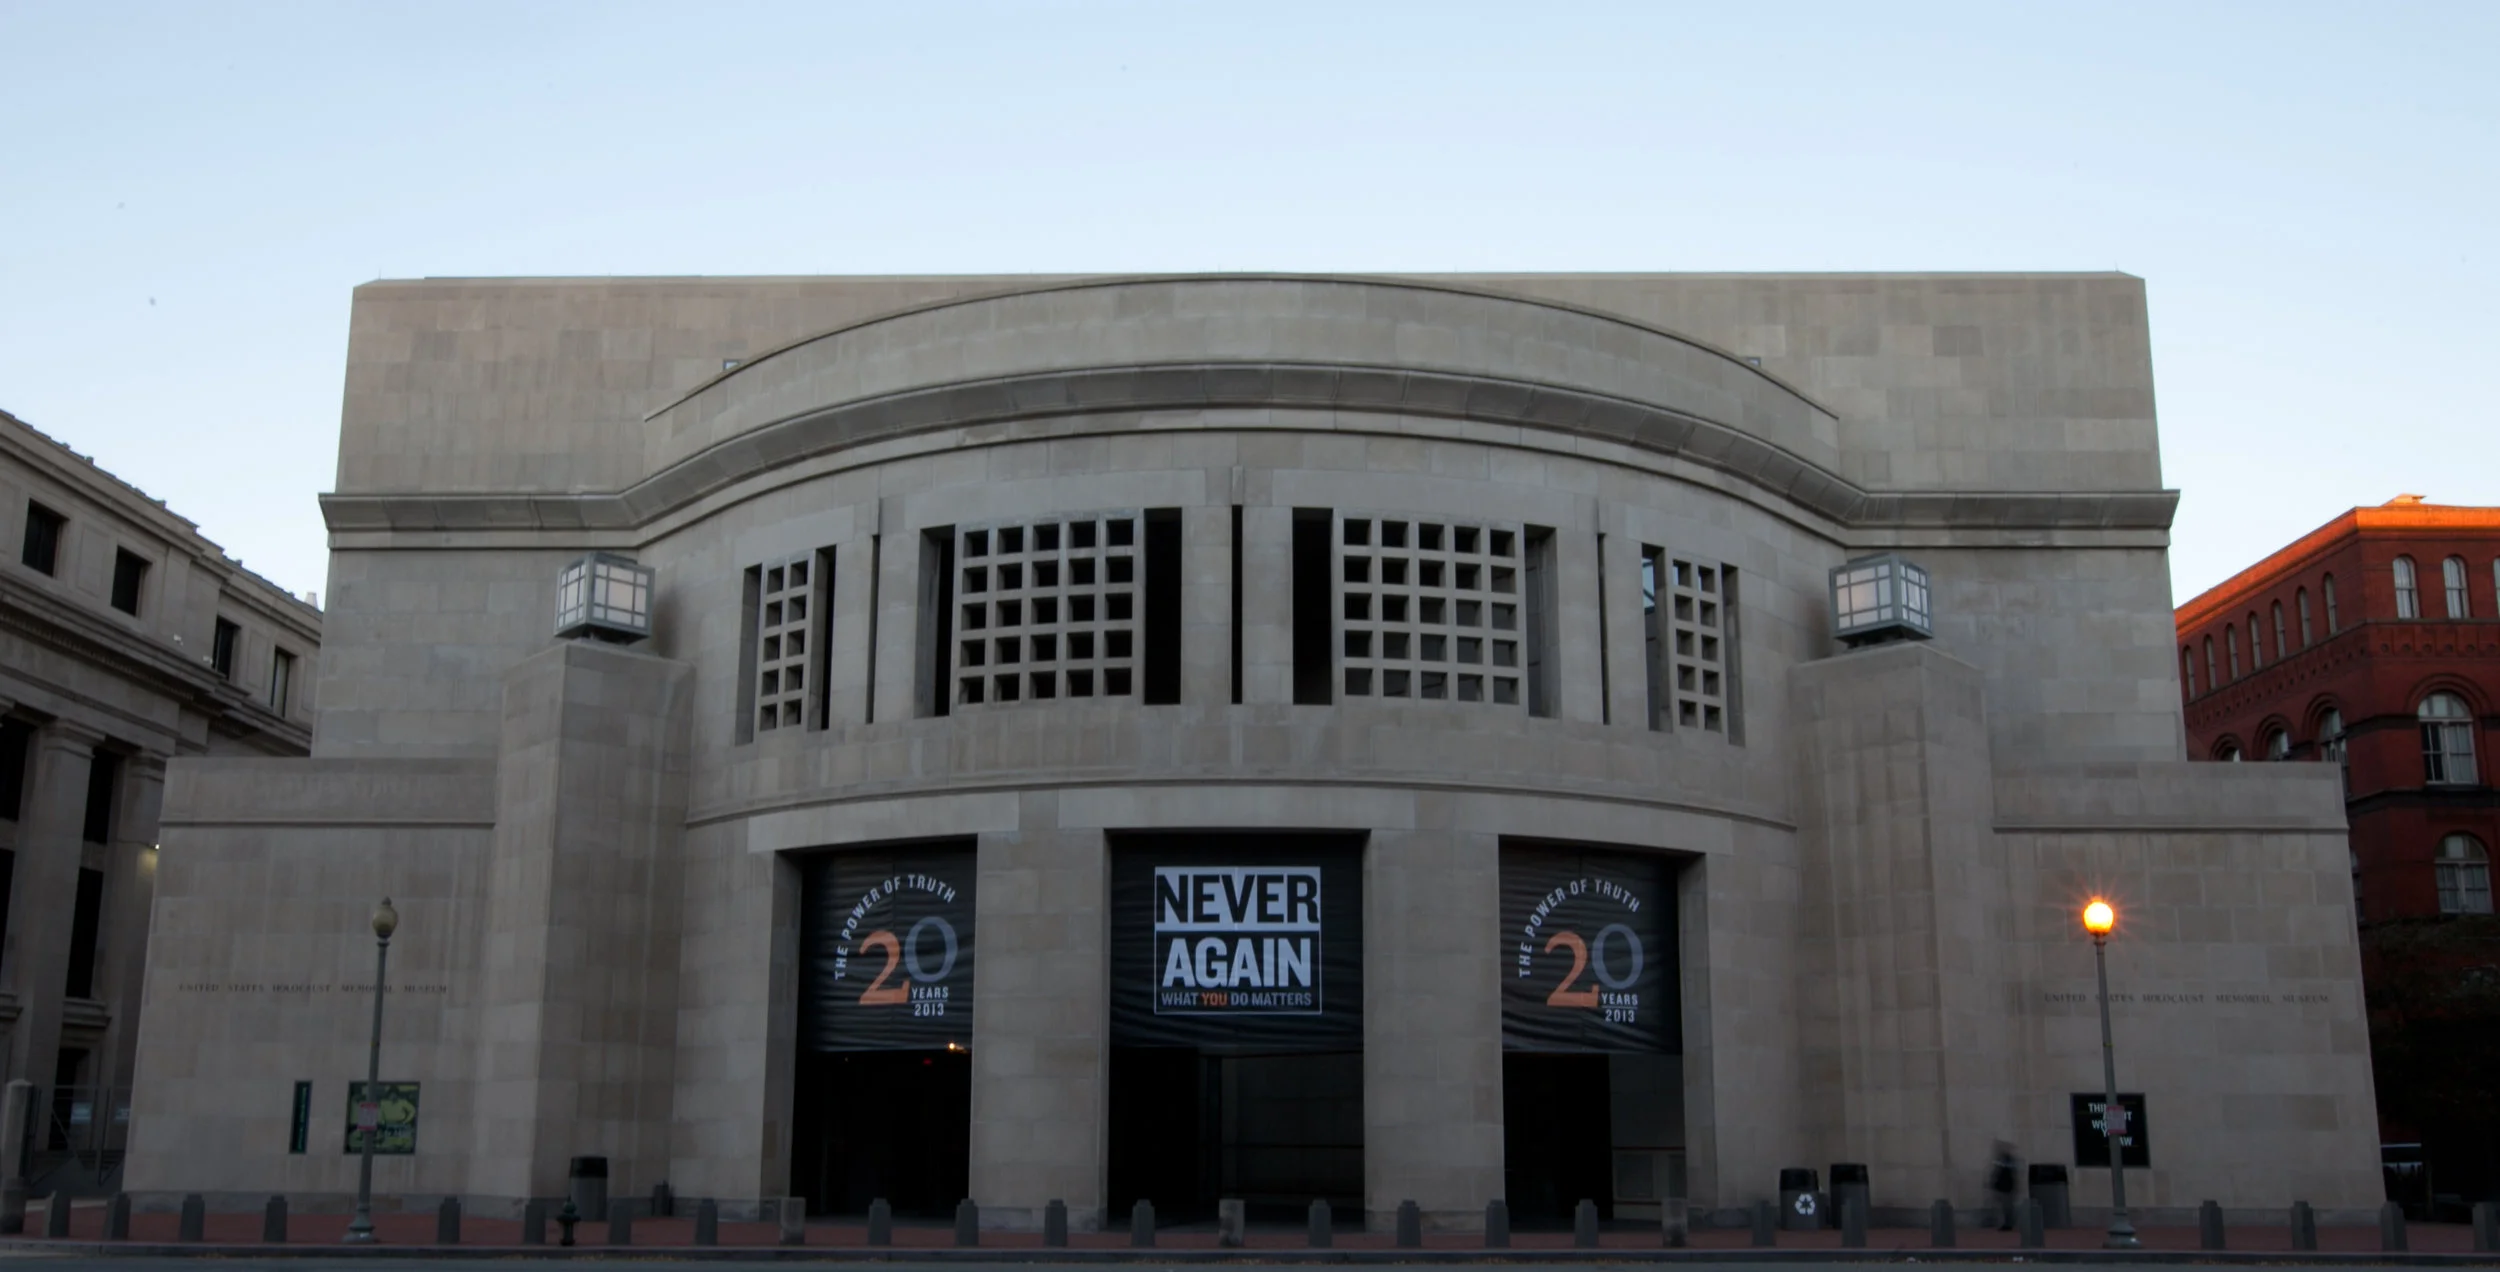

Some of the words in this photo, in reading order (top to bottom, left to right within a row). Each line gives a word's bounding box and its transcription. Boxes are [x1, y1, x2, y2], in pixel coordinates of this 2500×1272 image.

[884, 876, 901, 894] OF
[907, 874, 956, 903] TRUTH
[1155, 874, 1320, 924] NEVER
[1570, 878, 1588, 895] OF
[1594, 878, 1641, 913] TRUTH
[841, 888, 881, 941] POWER
[1524, 887, 1567, 938] POWER
[834, 945, 849, 981] THE
[858, 916, 958, 1006] 20
[1161, 936, 1312, 988] AGAIN
[1519, 942, 1533, 978] THE
[1544, 923, 1644, 1007] 20
[177, 983, 220, 993] UNITED
[228, 983, 264, 993] STATES
[272, 983, 331, 994] HOLOCAUST
[911, 986, 949, 999] YEARS
[1161, 992, 1200, 1007] WHAT
[1201, 992, 1228, 1007] YOU
[1231, 992, 1249, 1007] DO
[1252, 992, 1312, 1007] MATTERS
[1601, 992, 1639, 1006] YEARS
[2044, 992, 2087, 1003] UNITED
[2095, 992, 2135, 1003] SATES
[2142, 992, 2204, 1004] HOLOCAUST
[914, 1003, 945, 1017] 2013
[1604, 1009, 1636, 1023] 2013
